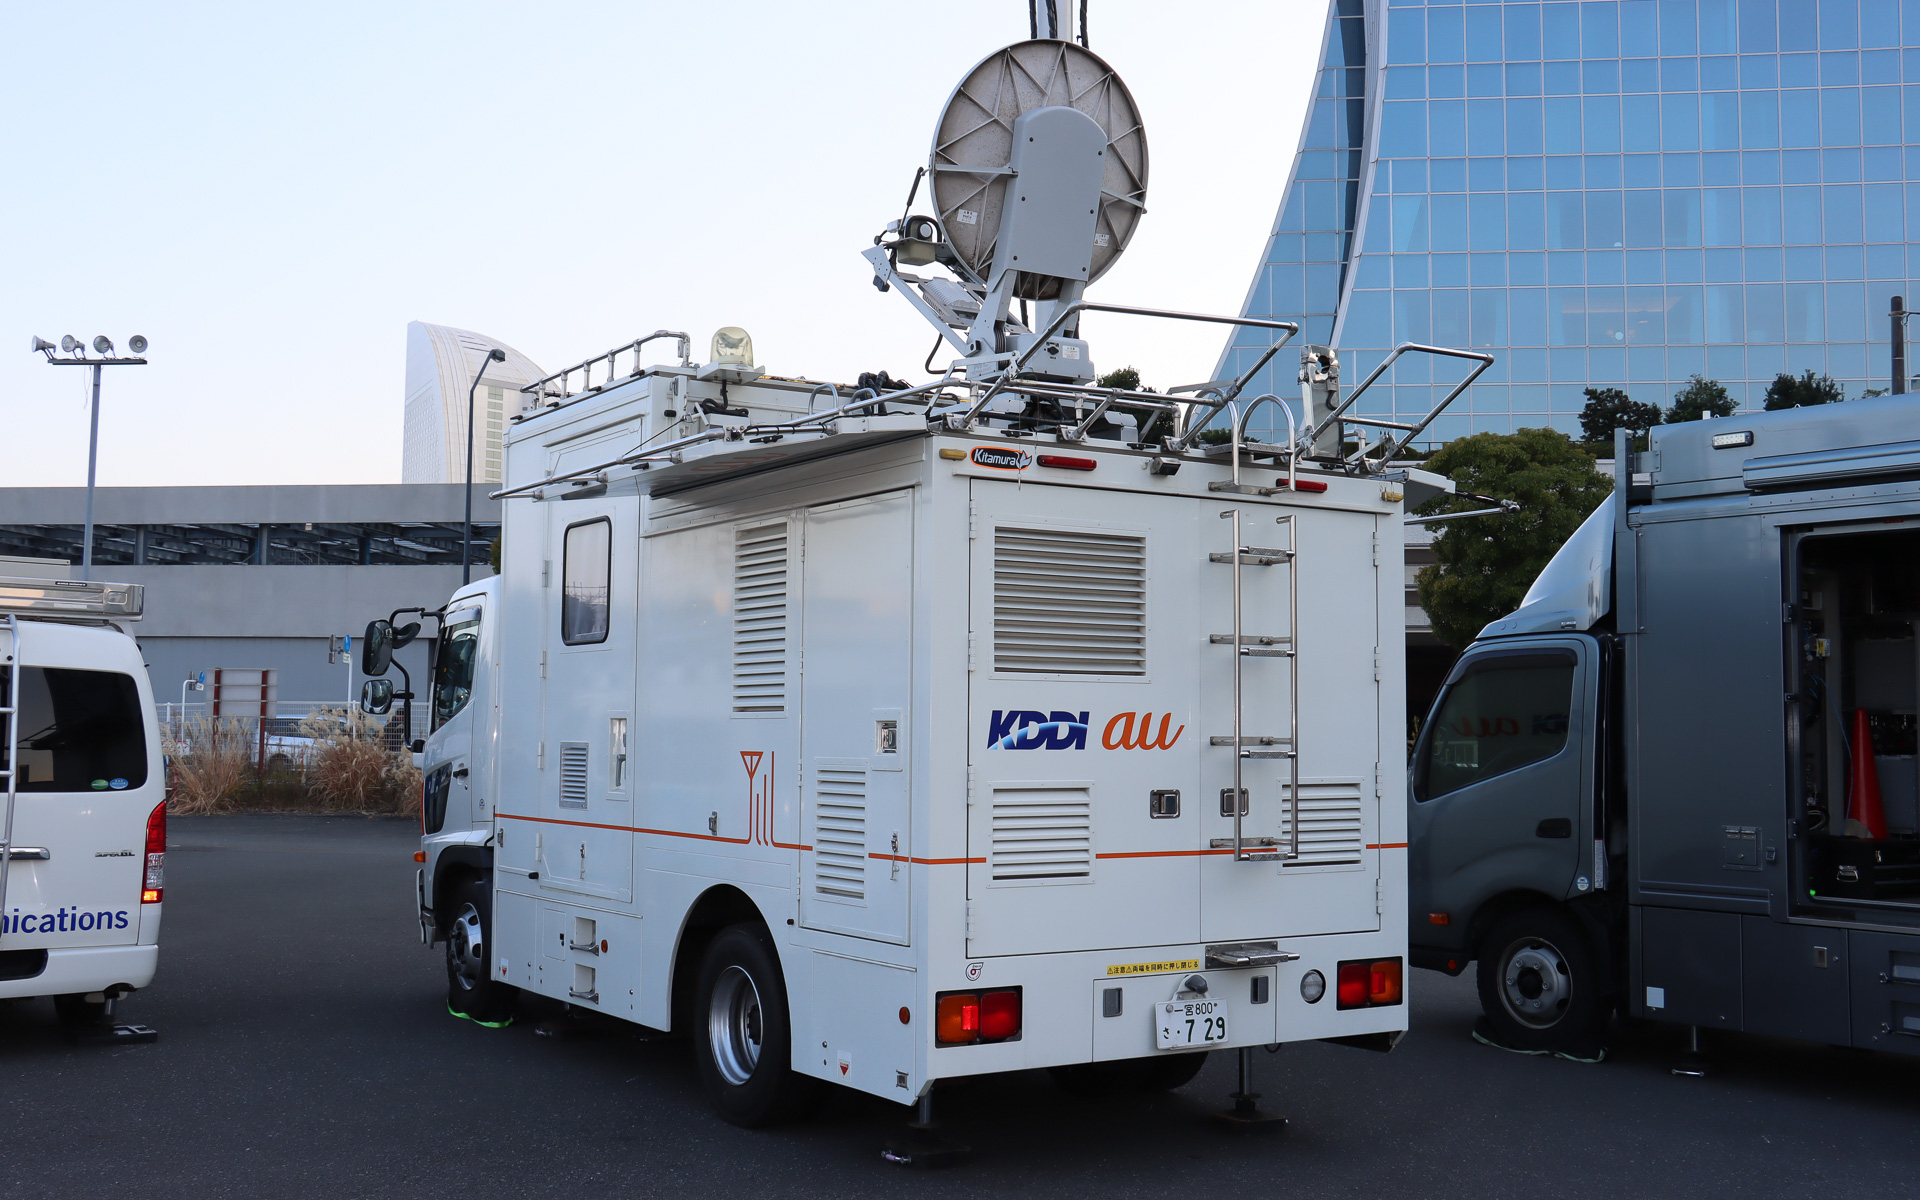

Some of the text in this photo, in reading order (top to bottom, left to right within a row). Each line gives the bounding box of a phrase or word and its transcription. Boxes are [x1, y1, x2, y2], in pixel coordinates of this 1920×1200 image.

[973, 448, 1016, 466] Kitamura
[987, 710, 1185, 750] KDDI au
